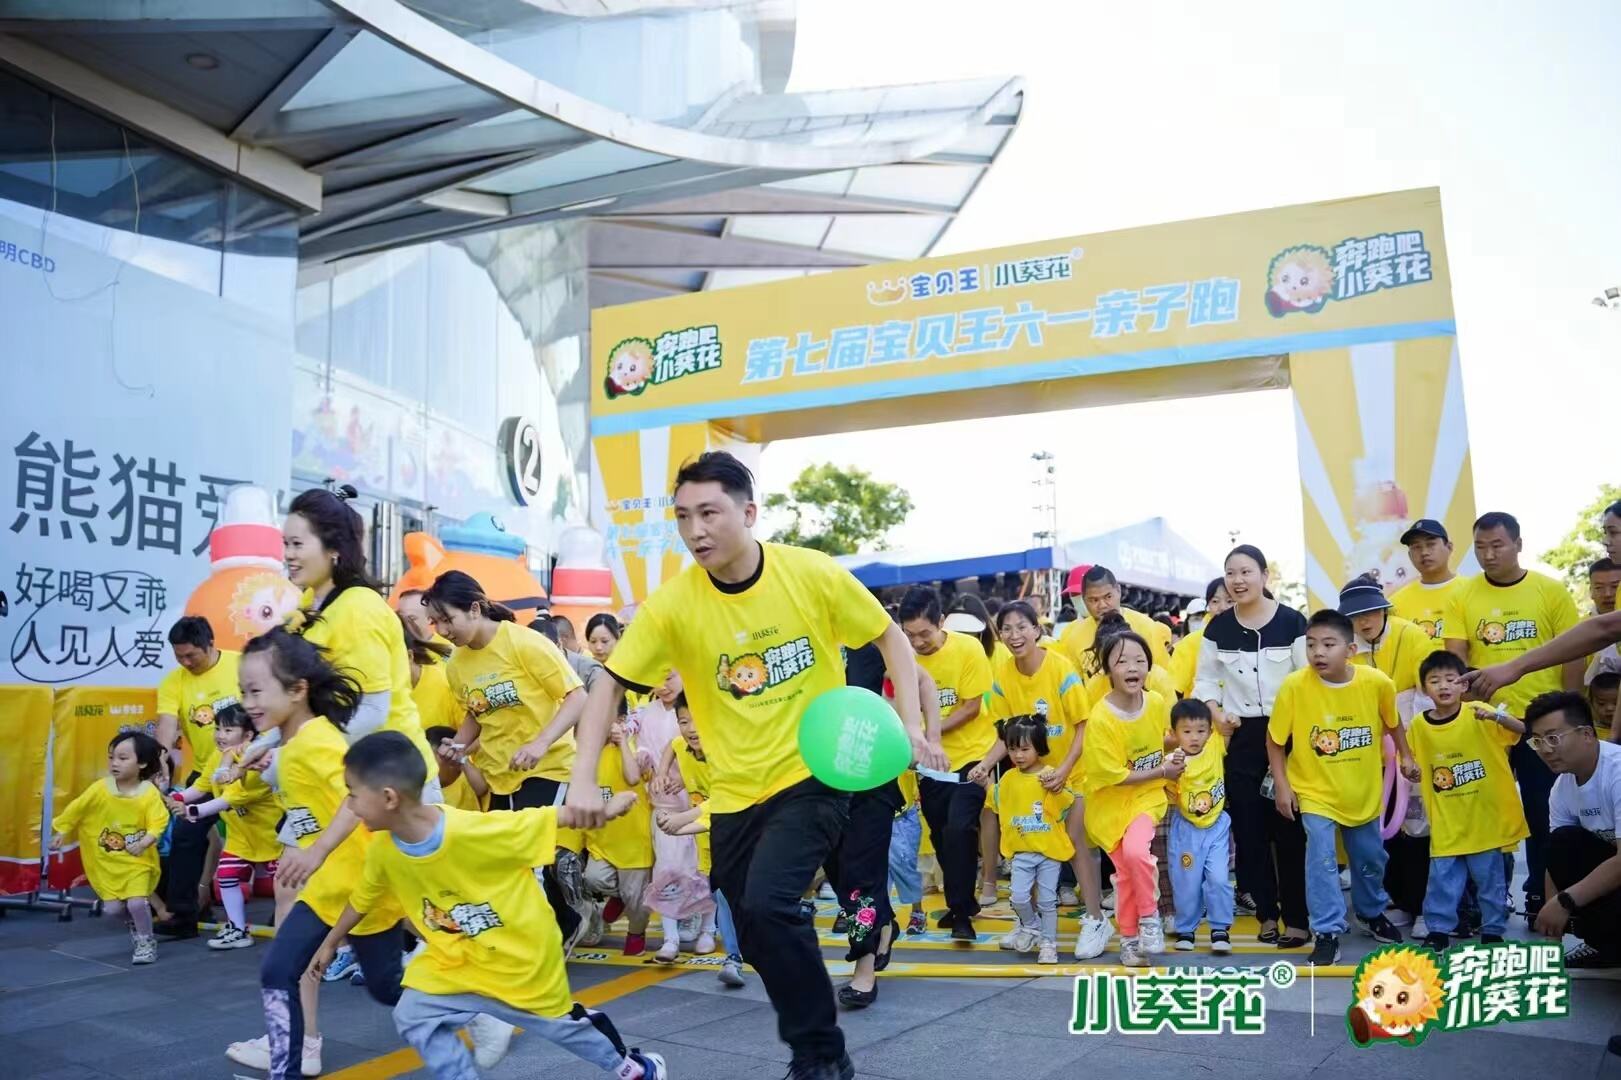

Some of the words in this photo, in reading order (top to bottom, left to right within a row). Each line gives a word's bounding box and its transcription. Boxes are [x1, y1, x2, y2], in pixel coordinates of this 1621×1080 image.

[911, 268, 979, 298] 宝贝王
[995, 256, 1070, 287] 小葵花
[1335, 232, 1422, 273] 奔跑吧
[1336, 252, 1431, 298] 小葵花
[740, 276, 1240, 384] 第七届宝贝王六一亲子跑
[521, 425, 541, 496] 2
[14, 562, 167, 617] 好喝又乖
[12, 620, 165, 669] 人见人爱
